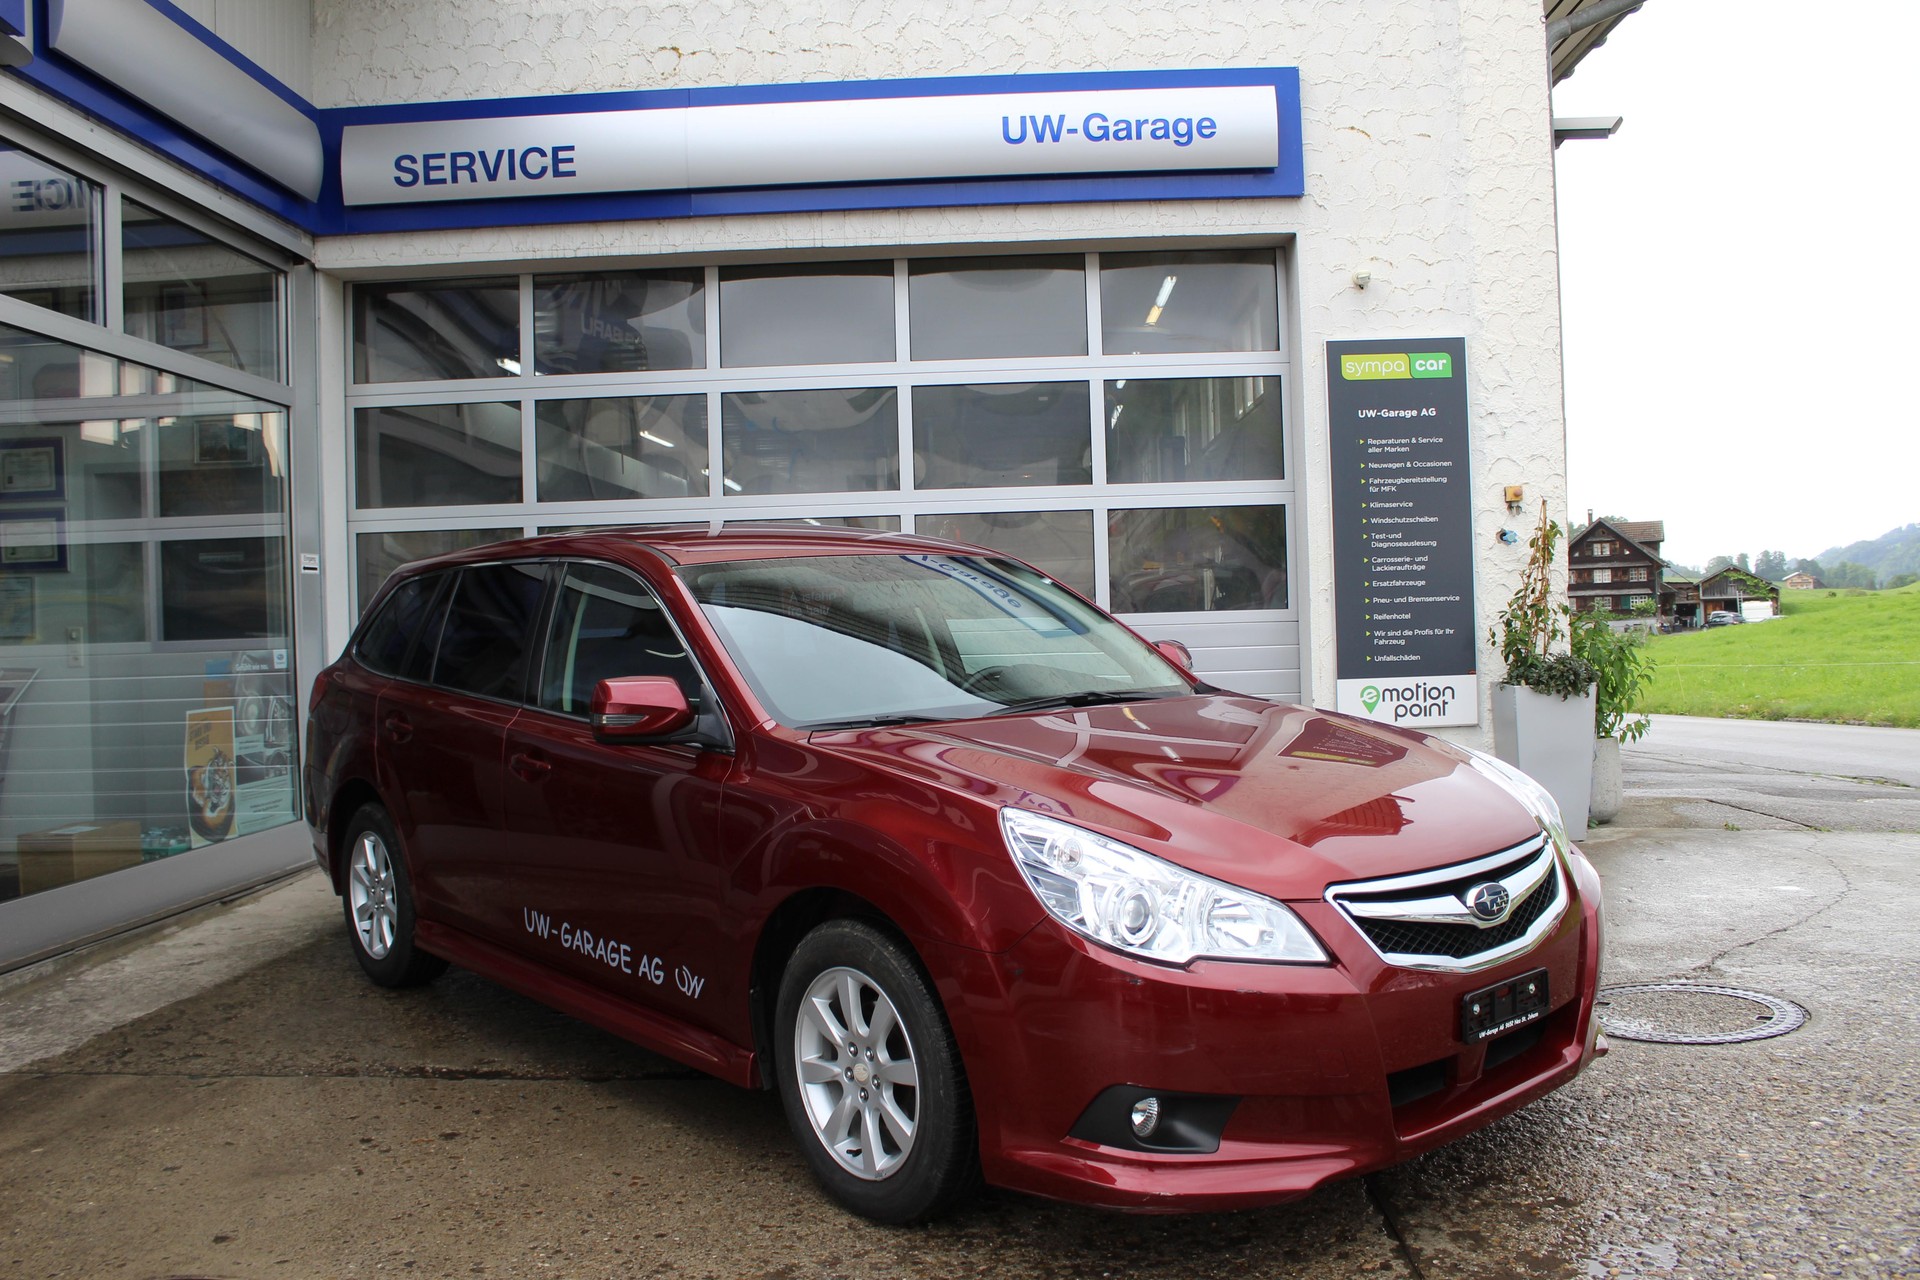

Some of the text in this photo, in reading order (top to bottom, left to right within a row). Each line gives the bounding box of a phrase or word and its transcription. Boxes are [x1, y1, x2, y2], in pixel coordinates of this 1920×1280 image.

[1001, 112, 1218, 148] UW-Garage
[393, 143, 577, 188] SERVICE
[1345, 357, 1447, 377] sympa car
[1358, 407, 1437, 419] UW-Garage AG
[1367, 437, 1410, 446] Reparaturen
[1418, 436, 1444, 444] Service
[1384, 445, 1410, 453] Marken
[1368, 462, 1405, 470] Neuwagen
[1369, 476, 1448, 485] Fahrzeugbereitstellung
[1381, 485, 1397, 493] MFK
[1370, 516, 1439, 524] Windschutzscheiben
[1371, 540, 1437, 549] Diagnoseauslesung
[1372, 564, 1426, 572] Lackieraufträge
[1372, 579, 1426, 587] Ersatzfahrzeuge
[1408, 594, 1460, 603] Bremsenservice
[1373, 612, 1411, 620] Reifenhotel
[1387, 629, 1401, 637] sind
[1414, 628, 1434, 636] Profis
[1374, 638, 1406, 646] Fahrzeug
[1374, 654, 1421, 662] Unfallschäden
[1394, 701, 1449, 722] point
[523, 906, 632, 975] UW-GARAGE
[638, 954, 665, 985] AG
